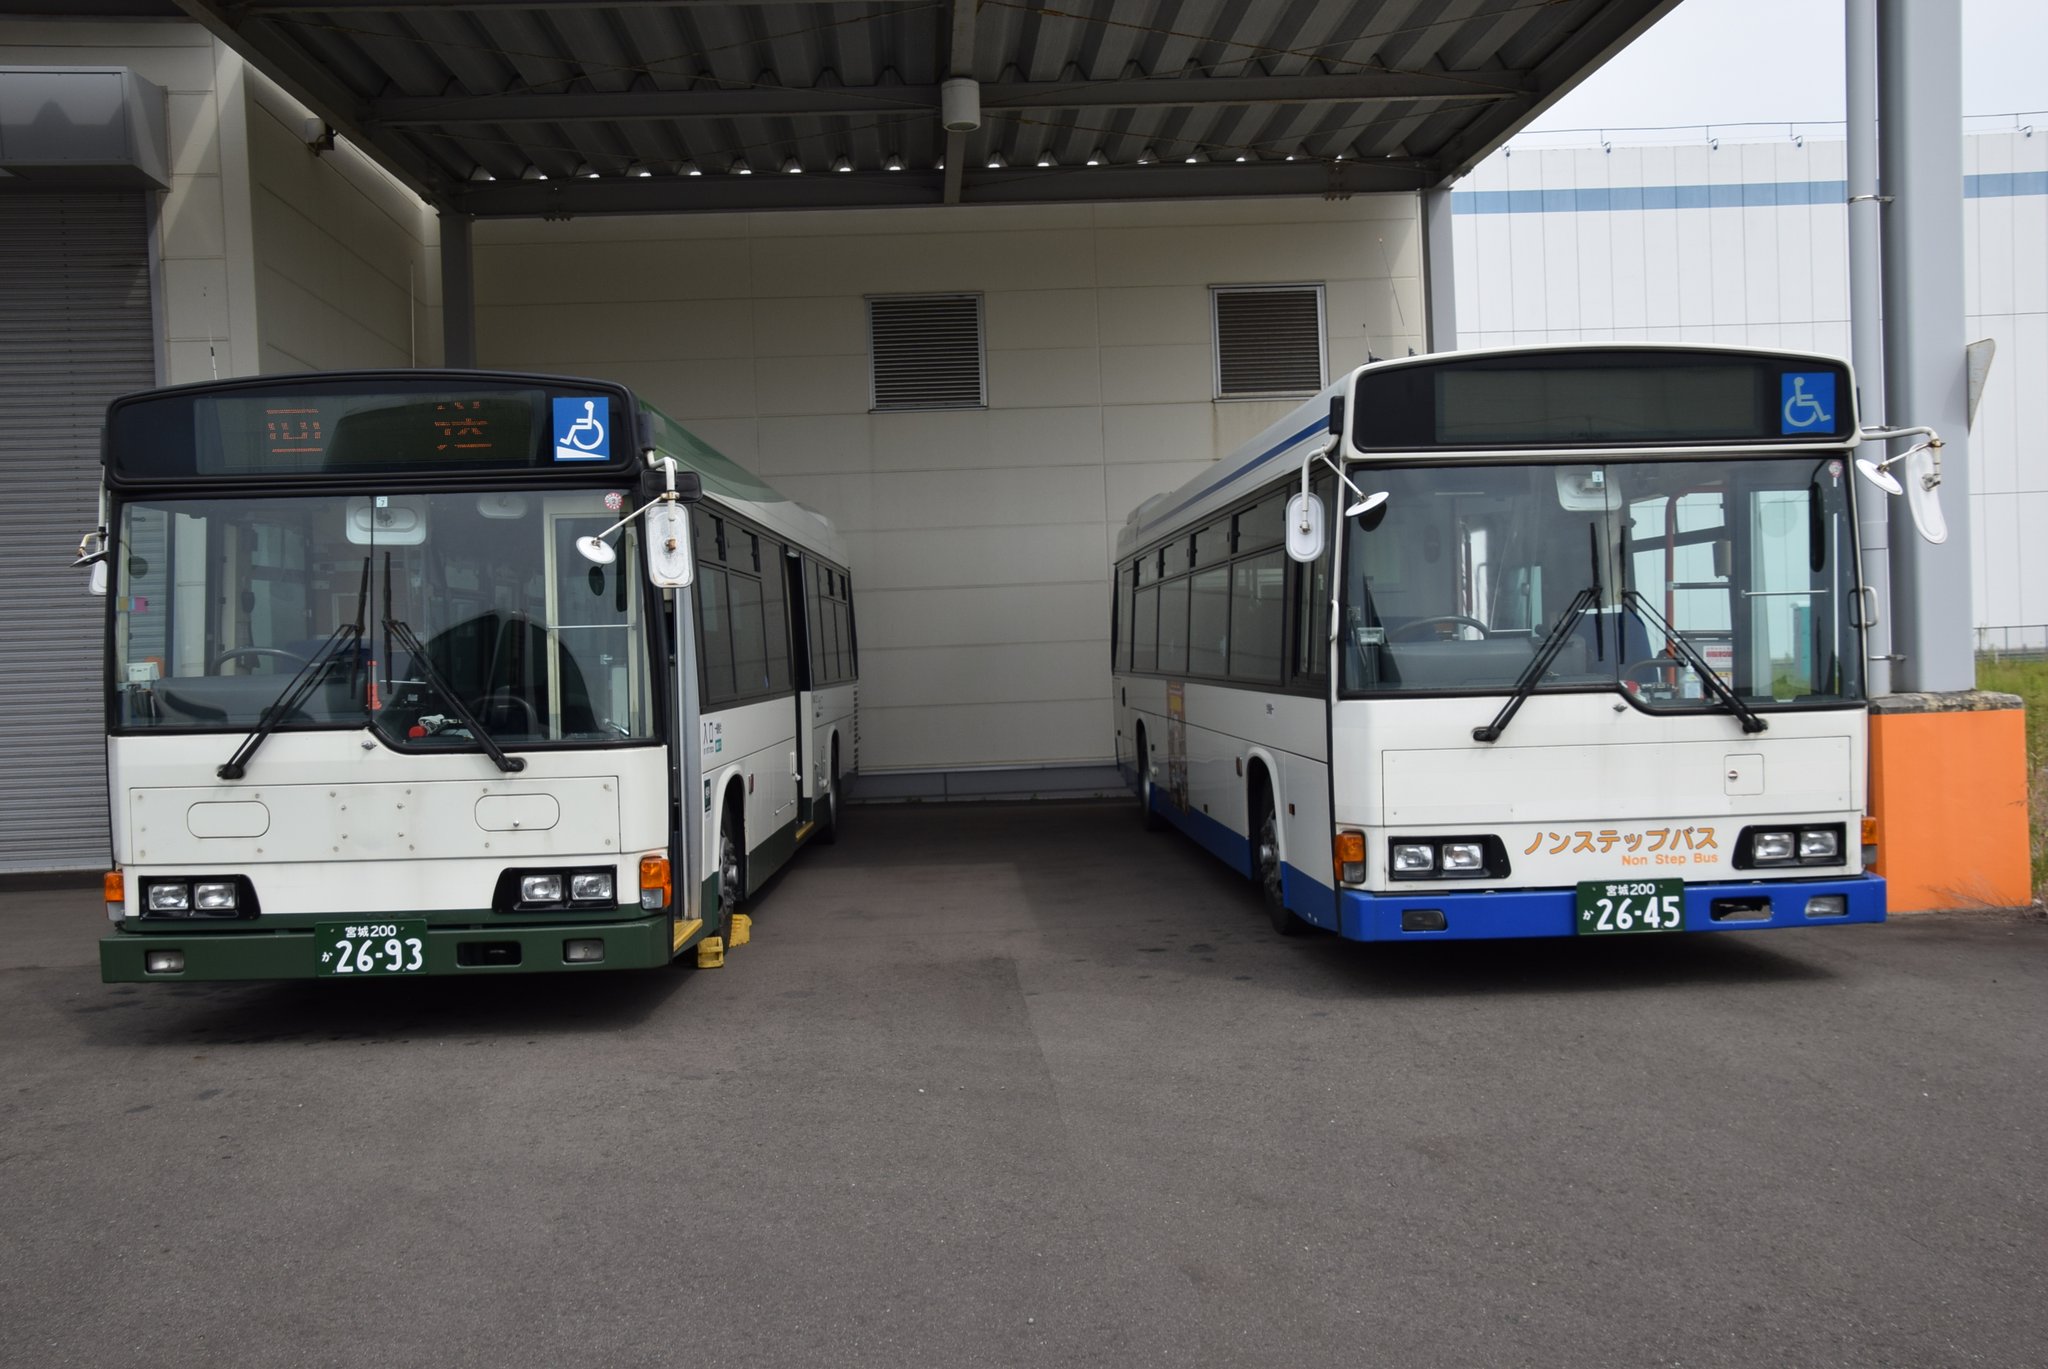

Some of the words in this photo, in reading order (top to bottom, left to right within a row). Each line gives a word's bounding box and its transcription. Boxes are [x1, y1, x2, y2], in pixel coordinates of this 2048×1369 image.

[1524, 827, 1718, 855] ノンステップバス
[1622, 855, 1648, 866] Non
[1655, 854, 1687, 866] Step
[1693, 852, 1718, 863] Bus
[1596, 895, 1681, 931] 26-45
[335, 937, 423, 973] 26-93
